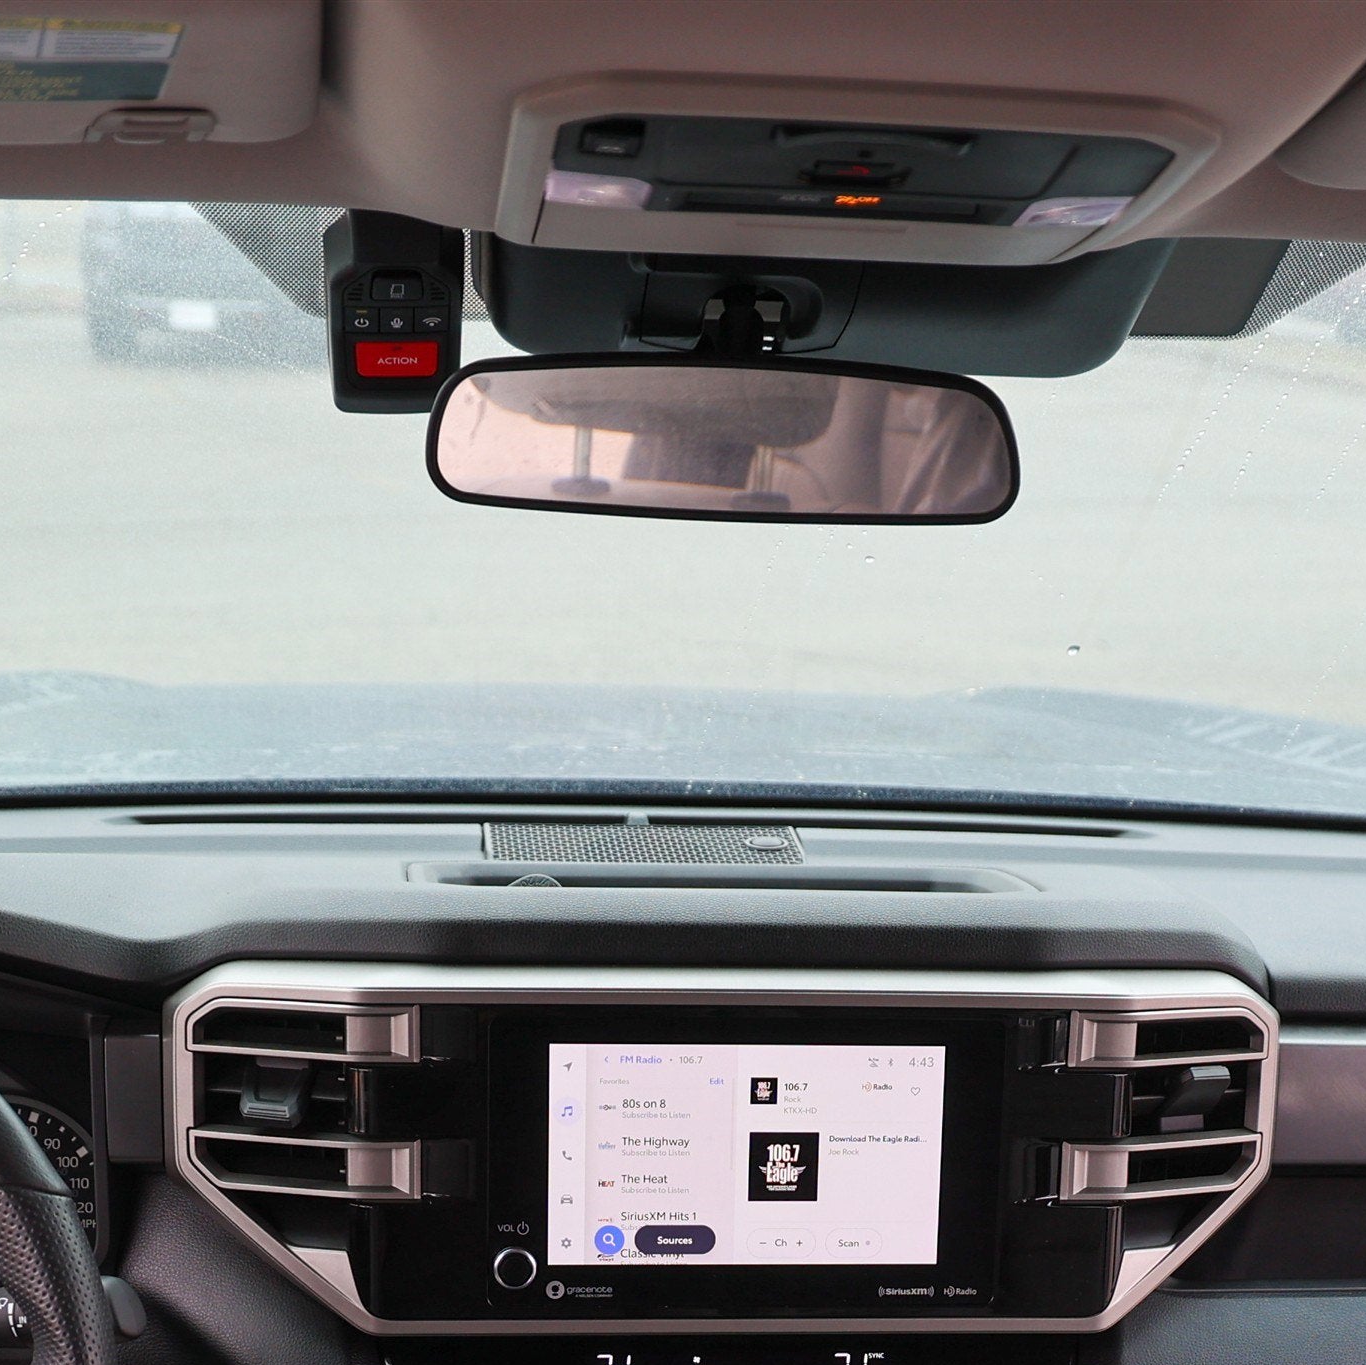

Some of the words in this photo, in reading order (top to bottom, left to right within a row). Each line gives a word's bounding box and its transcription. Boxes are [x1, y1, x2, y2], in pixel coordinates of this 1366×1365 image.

[377, 357, 418, 365] ACTION
[619, 1055, 634, 1064] FM
[636, 1055, 663, 1064] Radio
[679, 1056, 703, 1064] 106.7
[908, 1057, 935, 1068] 4:43
[599, 1077, 630, 1085] Favorites
[709, 1077, 725, 1085] Edit
[784, 1083, 808, 1091] 106.7
[873, 1083, 893, 1091] Radio
[622, 1098, 641, 1109] 80s
[643, 1101, 657, 1109] on
[659, 1098, 667, 1109] 8
[784, 1095, 802, 1103] Rock
[621, 1111, 659, 1119] Subscribe
[669, 1111, 691, 1119] Listen
[783, 1107, 818, 1115] KTKX-HD
[43, 1138, 61, 1150] 90
[622, 1136, 642, 1146] The
[643, 1136, 691, 1149] Highway
[828, 1135, 867, 1143] Download
[868, 1135, 881, 1143] The
[882, 1135, 903, 1145] Eagle
[621, 1149, 658, 1157] Subscribe
[668, 1149, 690, 1157] Listen
[766, 1144, 801, 1162] 106.7
[842, 1148, 859, 1156] Rock
[56, 1156, 79, 1168] 100
[766, 1162, 799, 1185] Eagle
[69, 1178, 90, 1189] 110
[621, 1174, 641, 1184] The
[643, 1174, 668, 1184] Heat
[621, 1186, 658, 1195] Subscribe
[668, 1186, 690, 1195] Listen
[75, 1201, 94, 1214] 20
[621, 1211, 666, 1221] SiriusXM
[669, 1211, 690, 1221] Hits
[497, 1223, 515, 1232] VOL
[657, 1236, 693, 1246] Sources
[774, 1238, 788, 1247] Ch
[837, 1239, 860, 1248] Scan
[566, 1285, 613, 1295] gracenote
[956, 1287, 978, 1296] Radio
